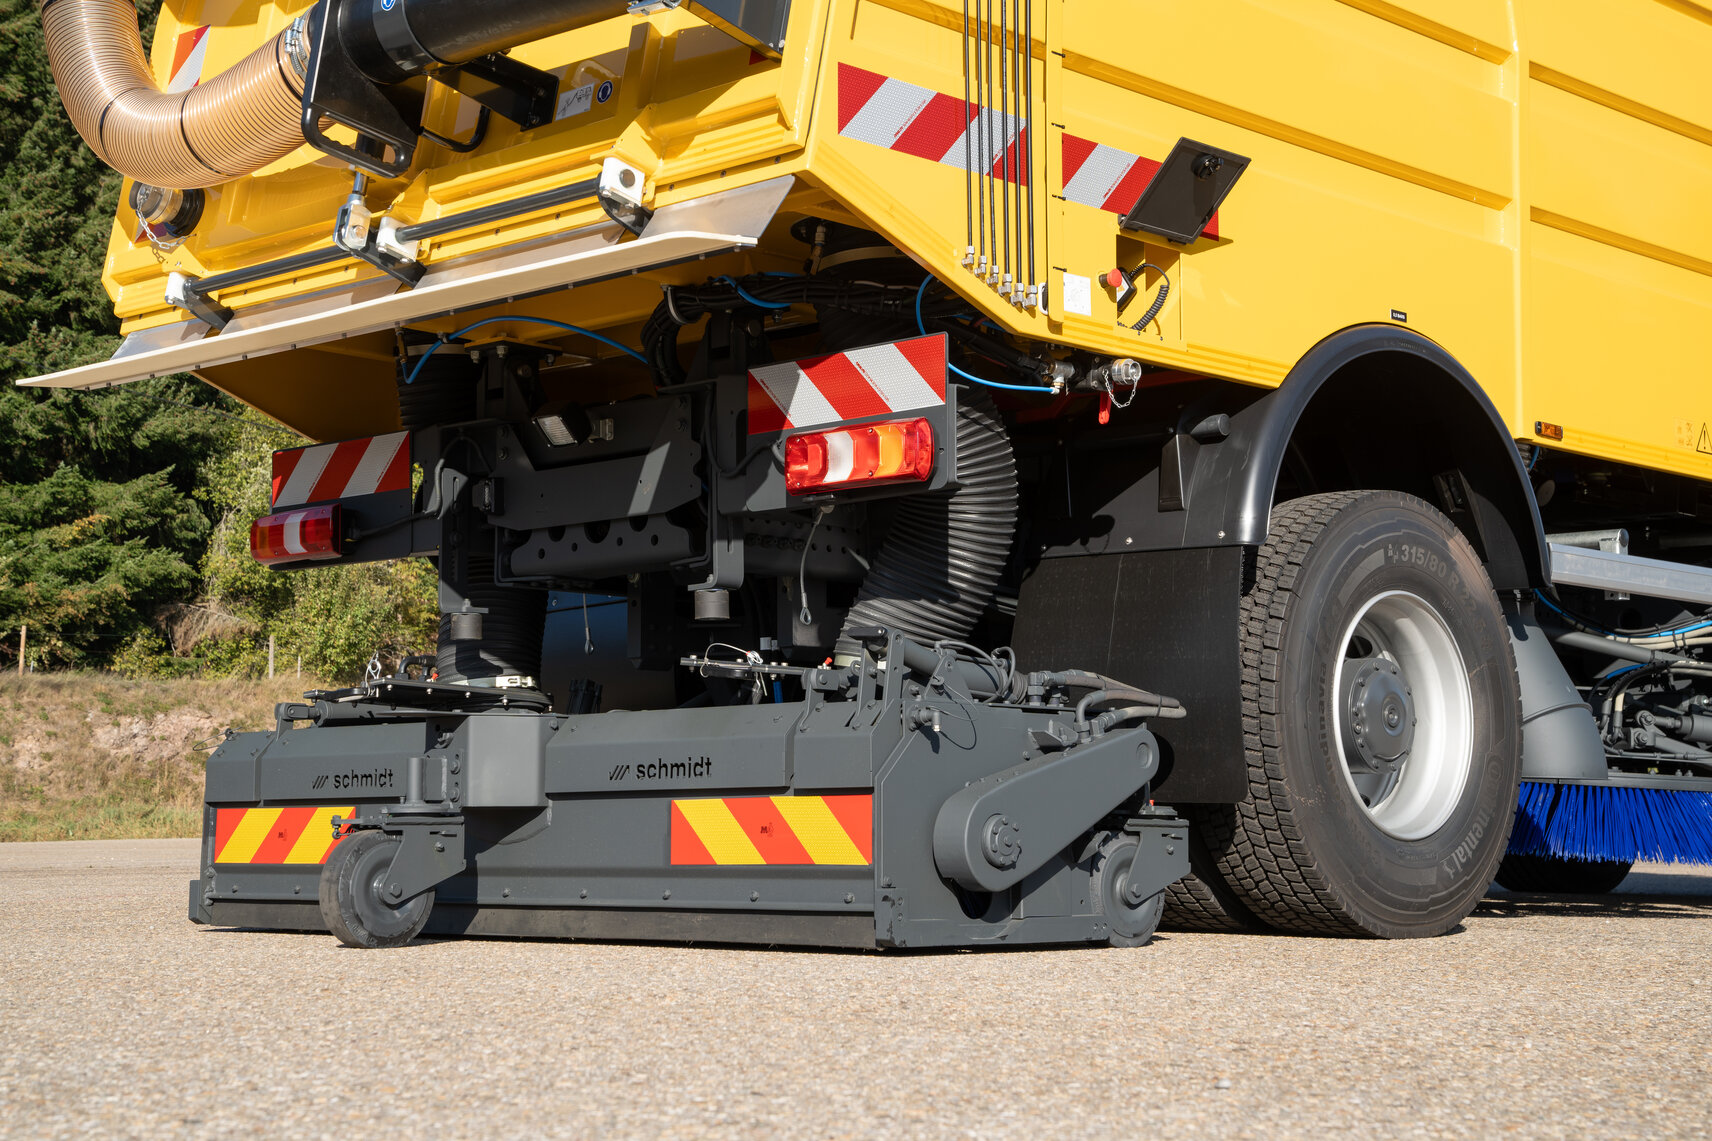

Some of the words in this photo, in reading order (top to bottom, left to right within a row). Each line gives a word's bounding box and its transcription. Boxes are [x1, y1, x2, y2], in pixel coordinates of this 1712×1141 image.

[1400, 544, 1447, 578] 315/80
[333, 768, 394, 789] schmidt
[636, 756, 712, 779] schmidt
